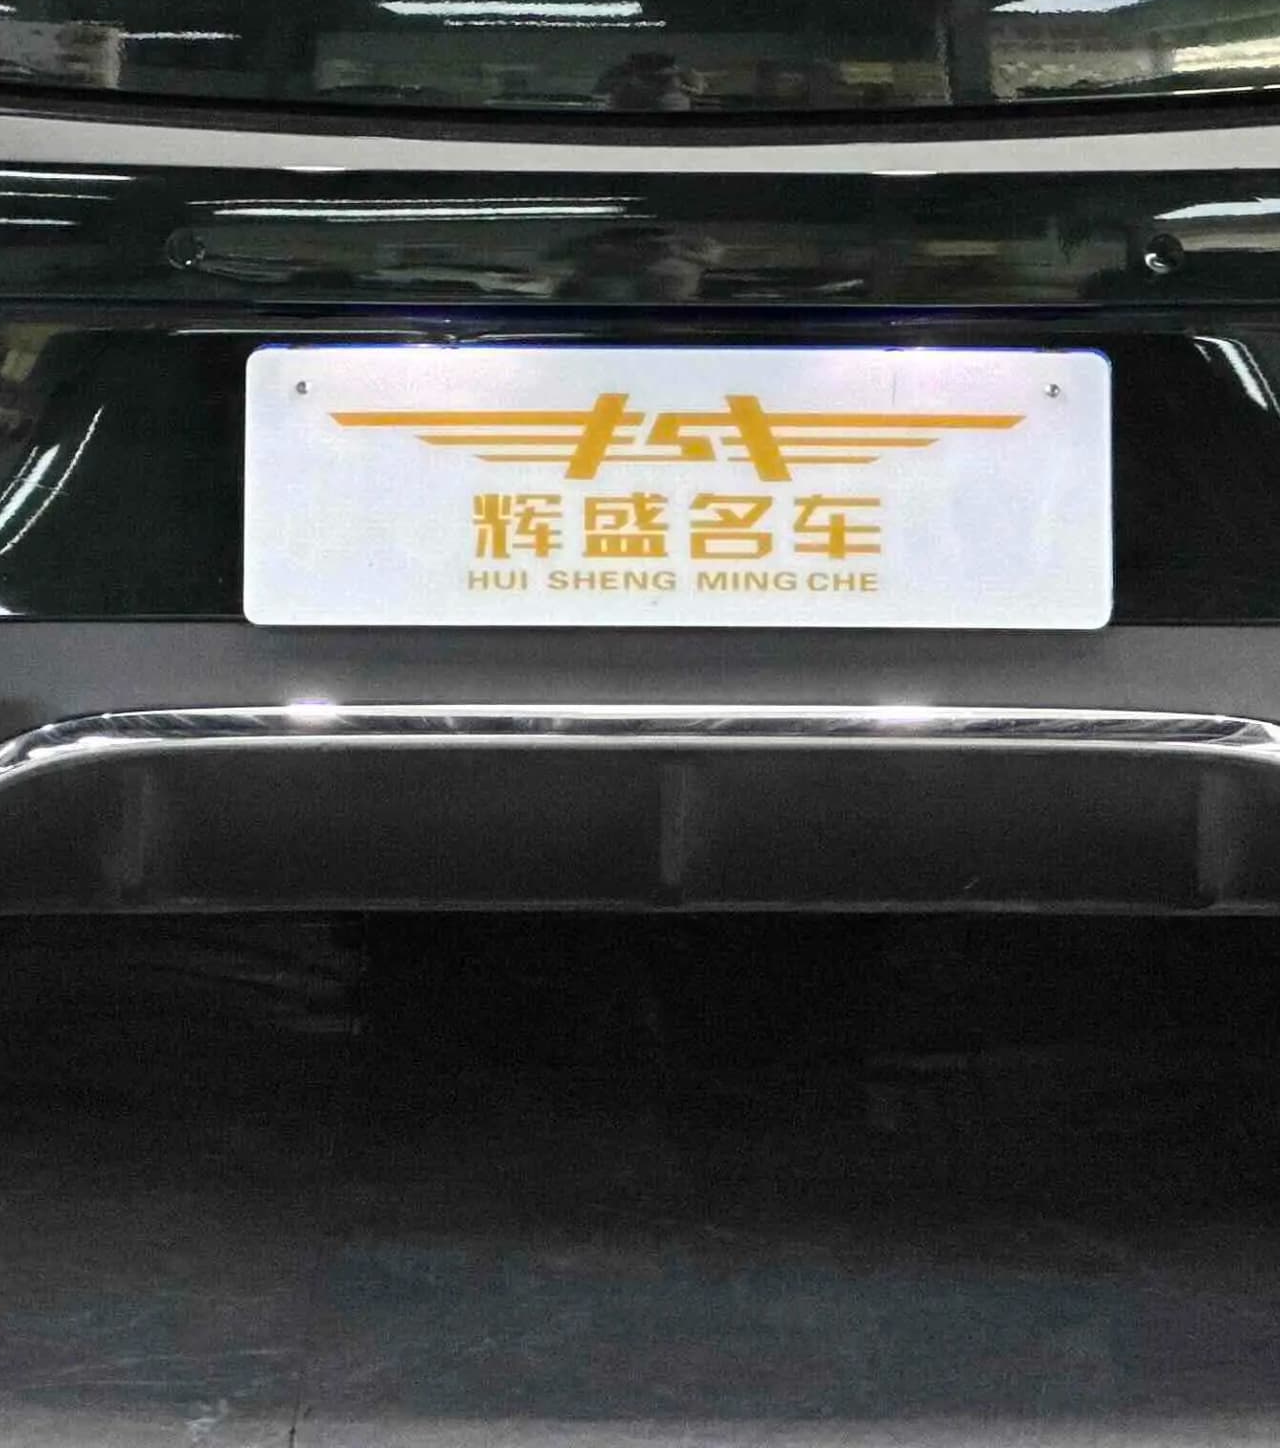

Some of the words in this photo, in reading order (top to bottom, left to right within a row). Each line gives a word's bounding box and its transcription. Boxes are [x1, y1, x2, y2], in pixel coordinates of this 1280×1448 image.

[472, 492, 881, 562] 辉盛名车
[467, 570, 528, 591] HUI
[547, 570, 677, 592] SHENG
[696, 570, 798, 593] MING
[806, 571, 878, 593] CHE
